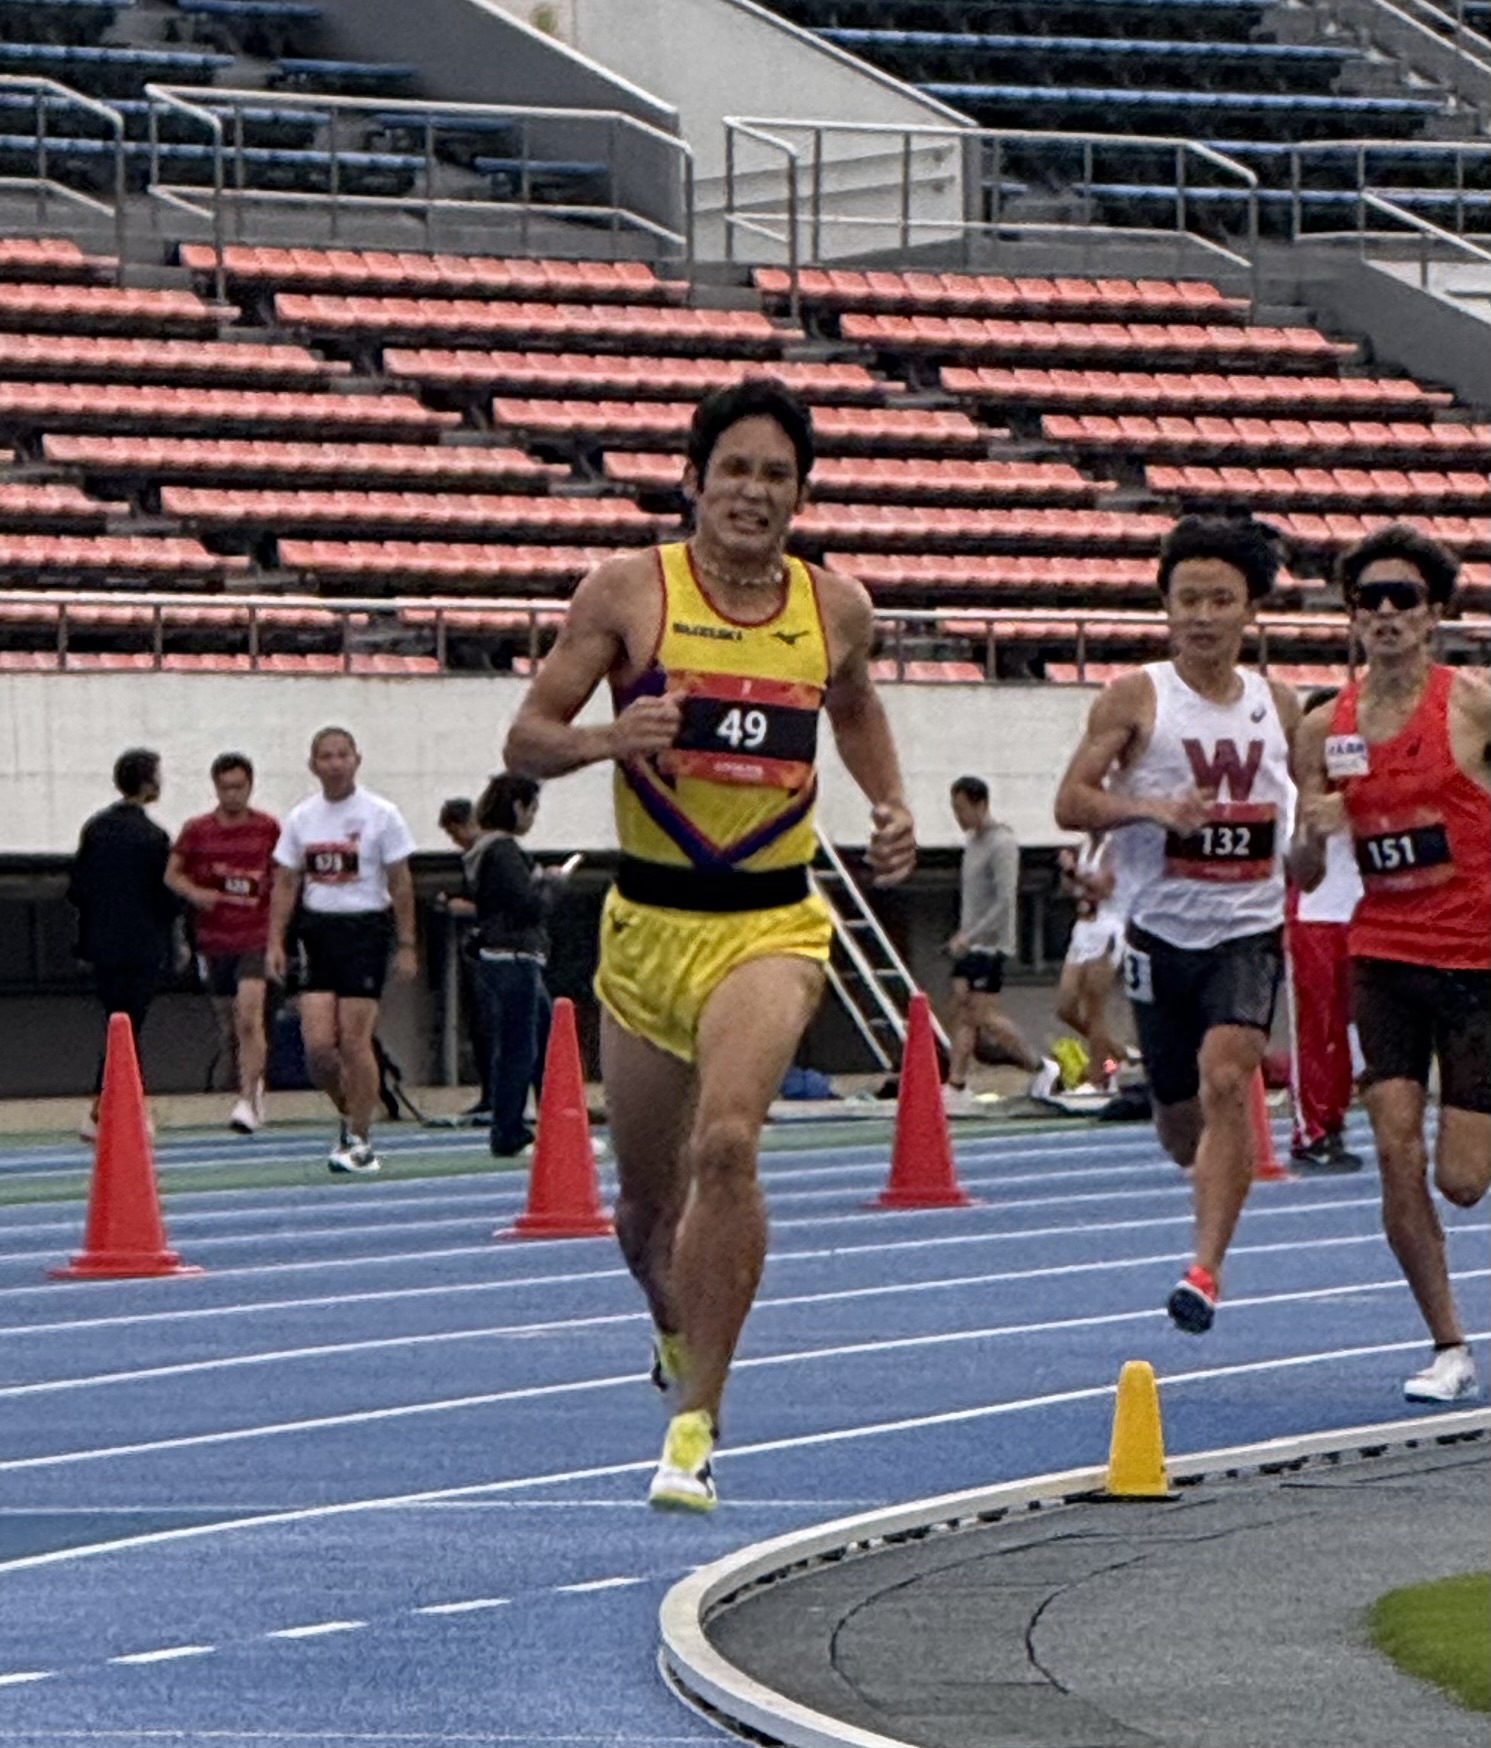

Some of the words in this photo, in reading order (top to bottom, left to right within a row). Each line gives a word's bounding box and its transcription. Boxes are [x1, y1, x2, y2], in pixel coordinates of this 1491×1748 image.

[716, 708, 768, 748] 49
[1181, 739, 1265, 801] W
[1201, 827, 1251, 856] 132
[1367, 836, 1415, 869] 151
